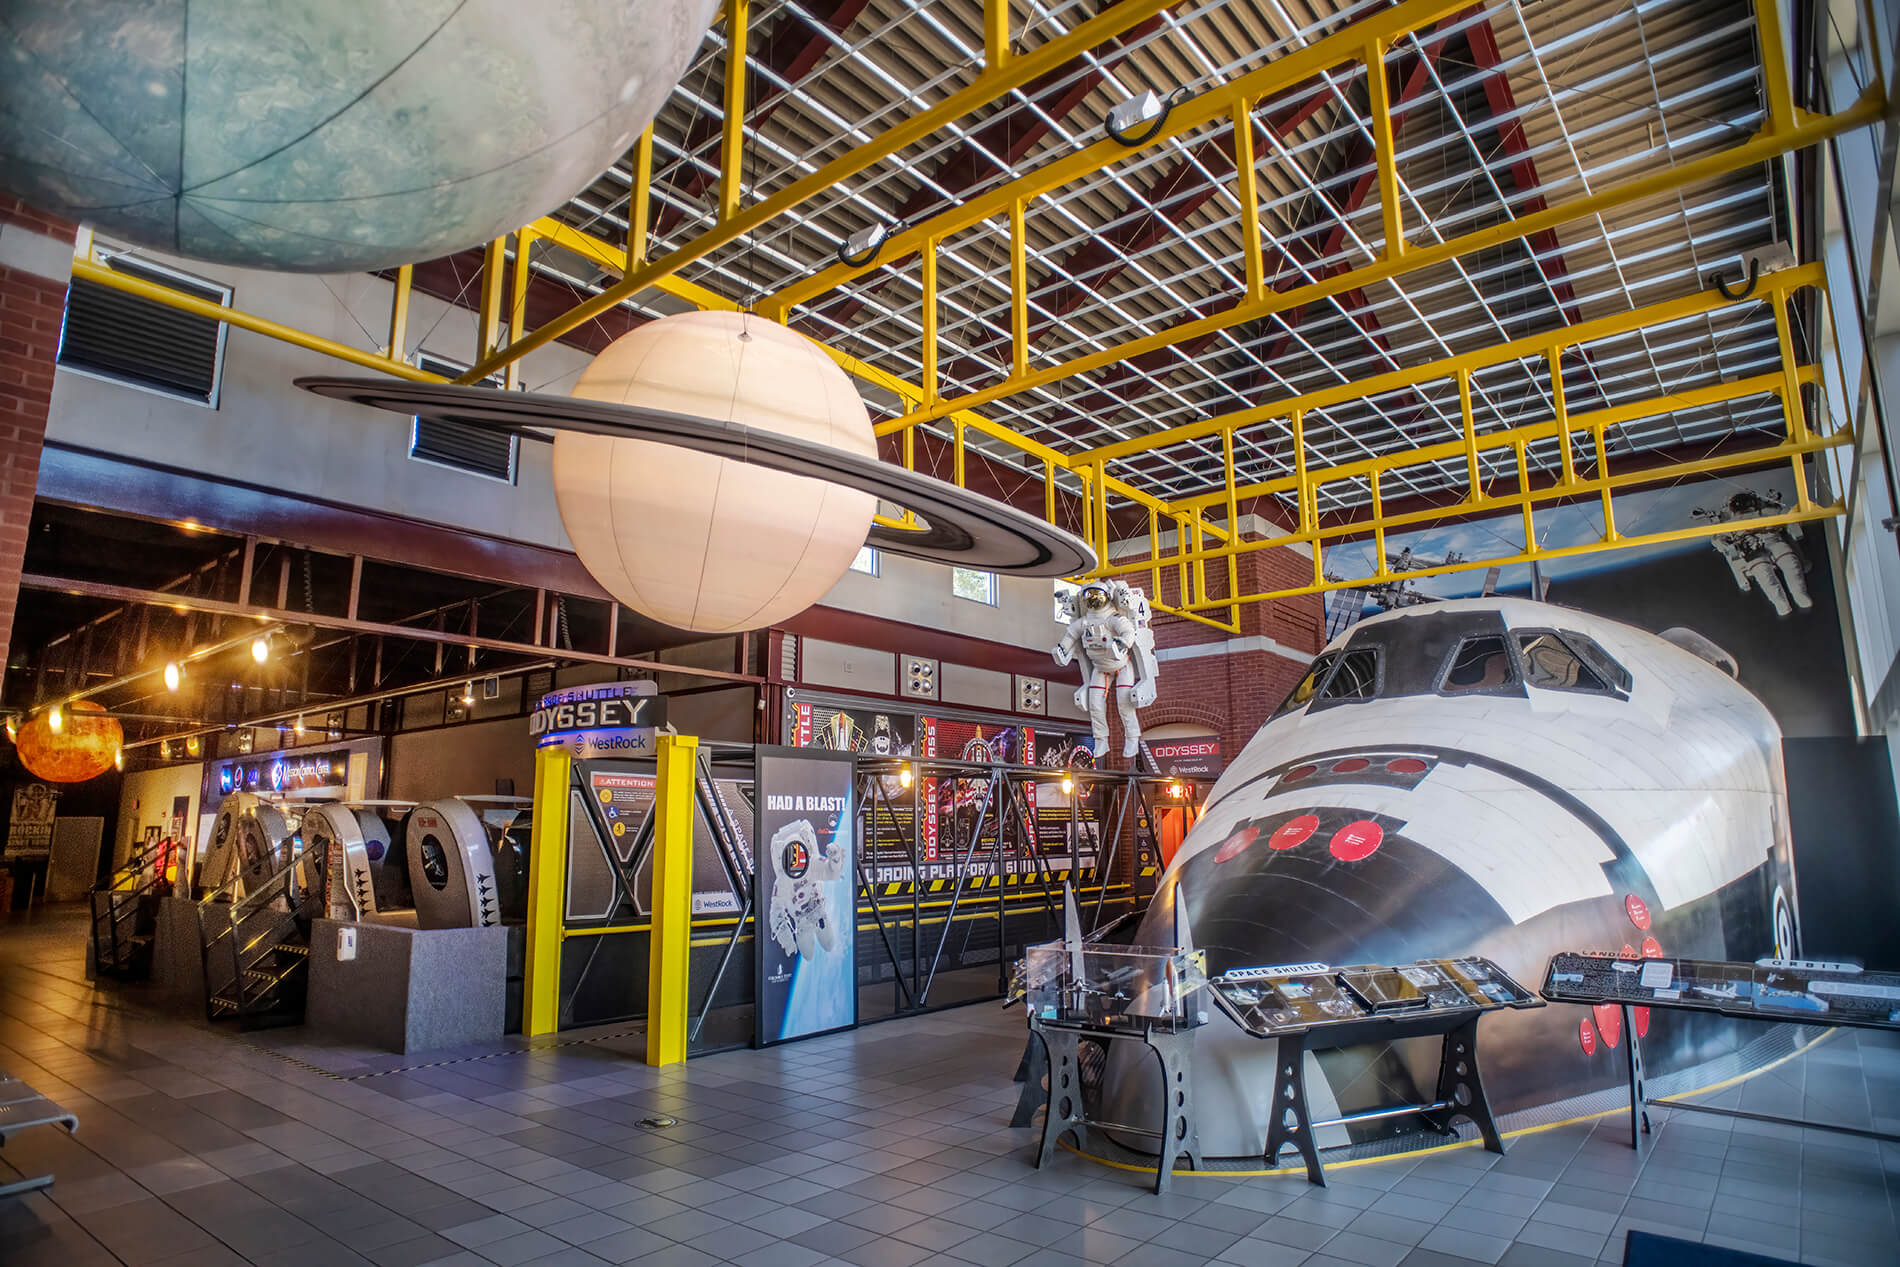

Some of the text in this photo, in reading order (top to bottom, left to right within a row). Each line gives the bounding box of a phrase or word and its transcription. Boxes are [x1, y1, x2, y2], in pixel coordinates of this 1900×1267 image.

[1138, 602, 1145, 616] 4
[529, 699, 648, 736] ODYSSEY
[588, 736, 646, 750] WestRock
[1155, 744, 1215, 758] ODYSSEY
[607, 778, 653, 787] ATTENTION
[767, 795, 846, 812] HAD A BLAST!
[926, 782, 937, 858] ODYSSEY
[865, 865, 926, 882] LOADING
[930, 862, 995, 879] PLATORM
[1582, 950, 1638, 958] LANDING
[1230, 964, 1327, 977] SPACE SHUTTLE
[1772, 960, 1841, 970] ORBIT
